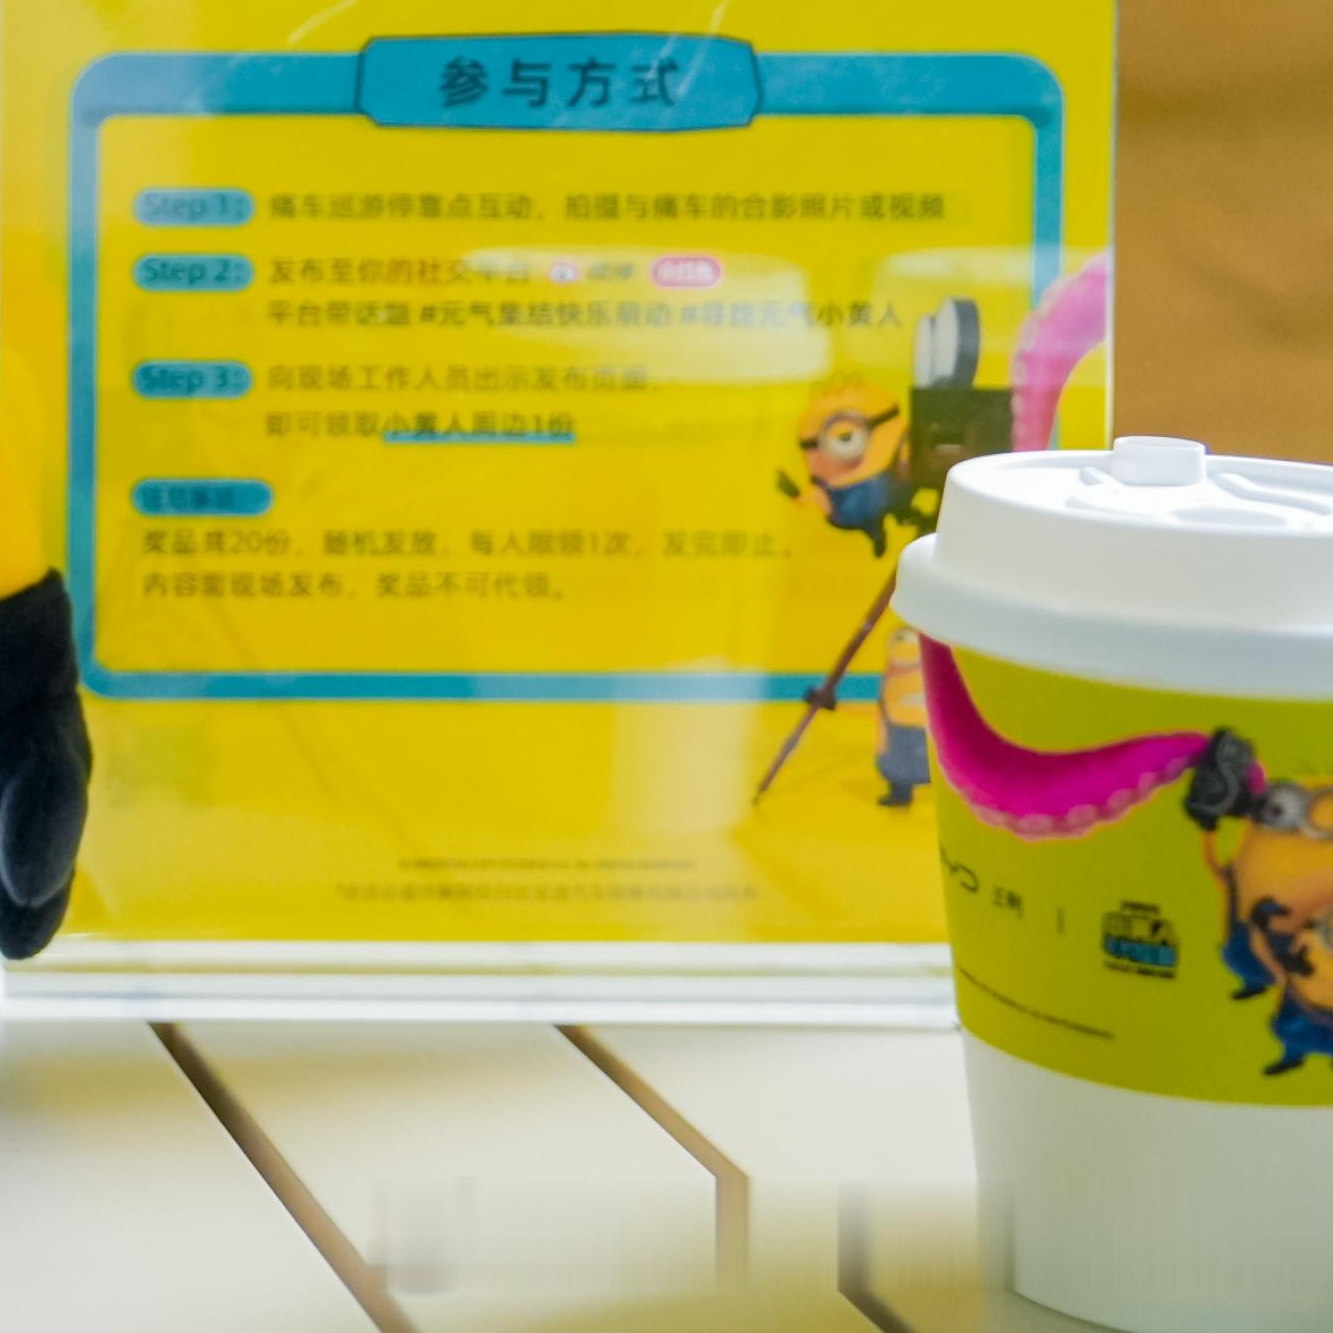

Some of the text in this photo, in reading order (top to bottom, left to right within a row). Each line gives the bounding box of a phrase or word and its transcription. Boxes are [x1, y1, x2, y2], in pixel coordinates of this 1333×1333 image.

[440, 57, 680, 110] 参与方式
[145, 195, 206, 221] Step
[144, 259, 206, 286] Step
